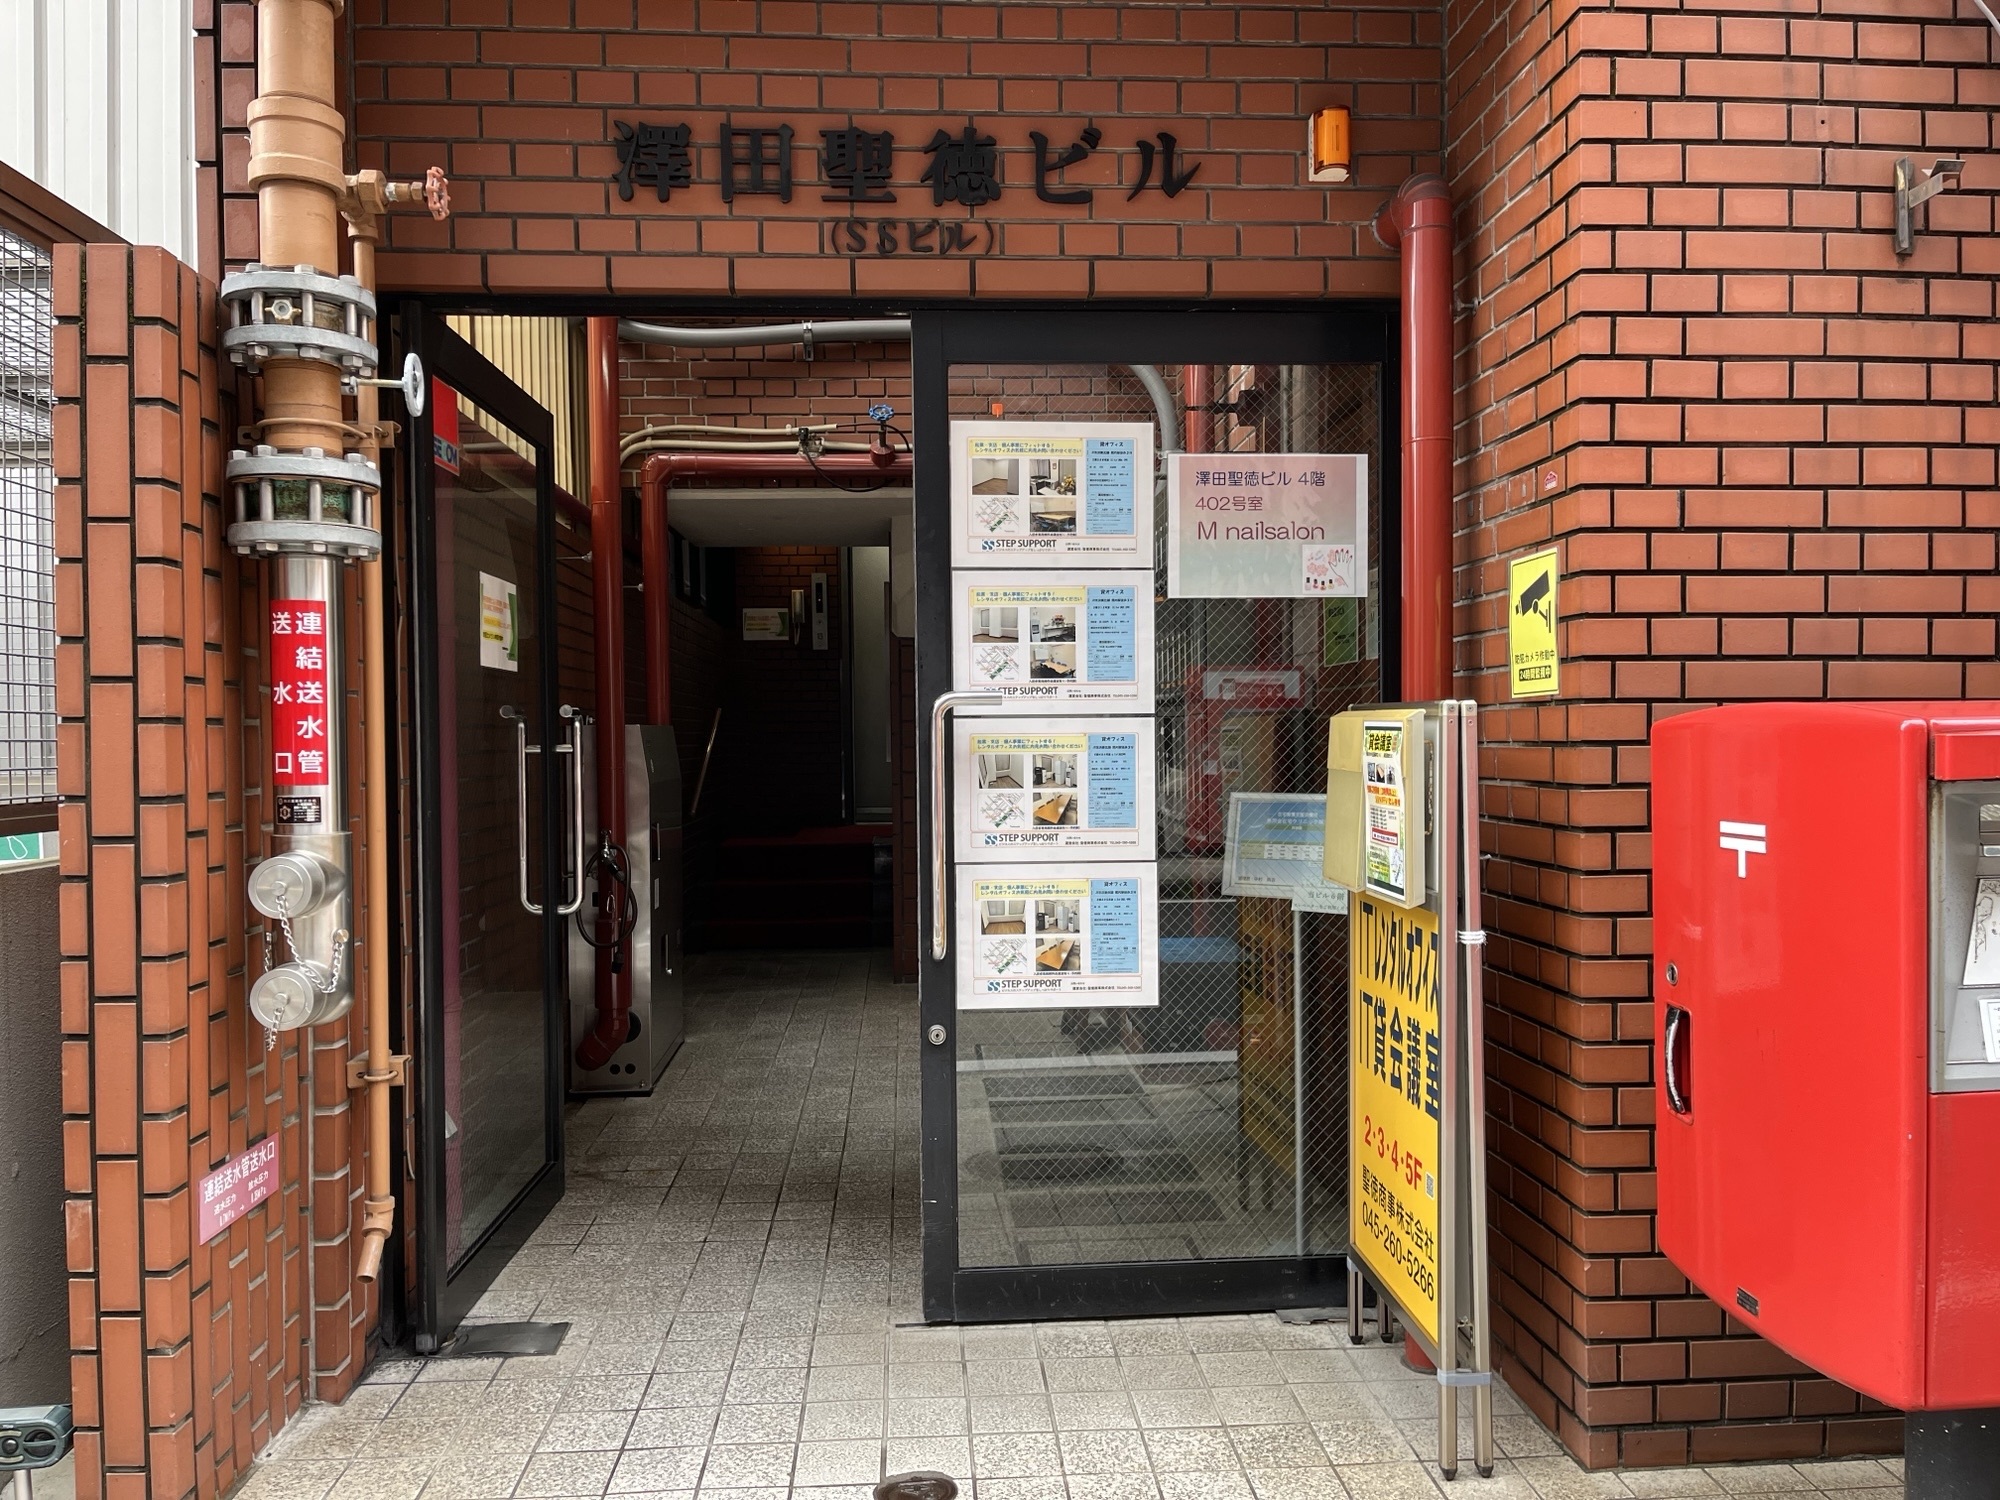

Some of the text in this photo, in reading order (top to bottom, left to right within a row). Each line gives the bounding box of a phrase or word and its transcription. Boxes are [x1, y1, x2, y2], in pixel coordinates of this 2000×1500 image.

[612, 119, 1202, 205] 澤田聖徳ビル
[1195, 471, 1326, 487] 澤田聖徳ビル 4階
[1195, 496, 1263, 511] 402号室
[1198, 521, 1325, 540] M nailsalon
[1515, 650, 1555, 664] 防犯カメラ作動中
[272, 611, 293, 774] 送水口
[296, 611, 324, 774] 連結送水管
[1020, 687, 1058, 695] SUPPORT
[999, 833, 1019, 841] STEP
[1021, 833, 1059, 841] SUPPORT
[1001, 979, 1022, 988] STEP
[1023, 979, 1062, 988] SUPPORT
[204, 1142, 274, 1204] 連結送水管送水口
[1362, 1164, 1434, 1263] 聖徳商事株式会社
[1362, 1201, 1434, 1302] 045-260-5266
